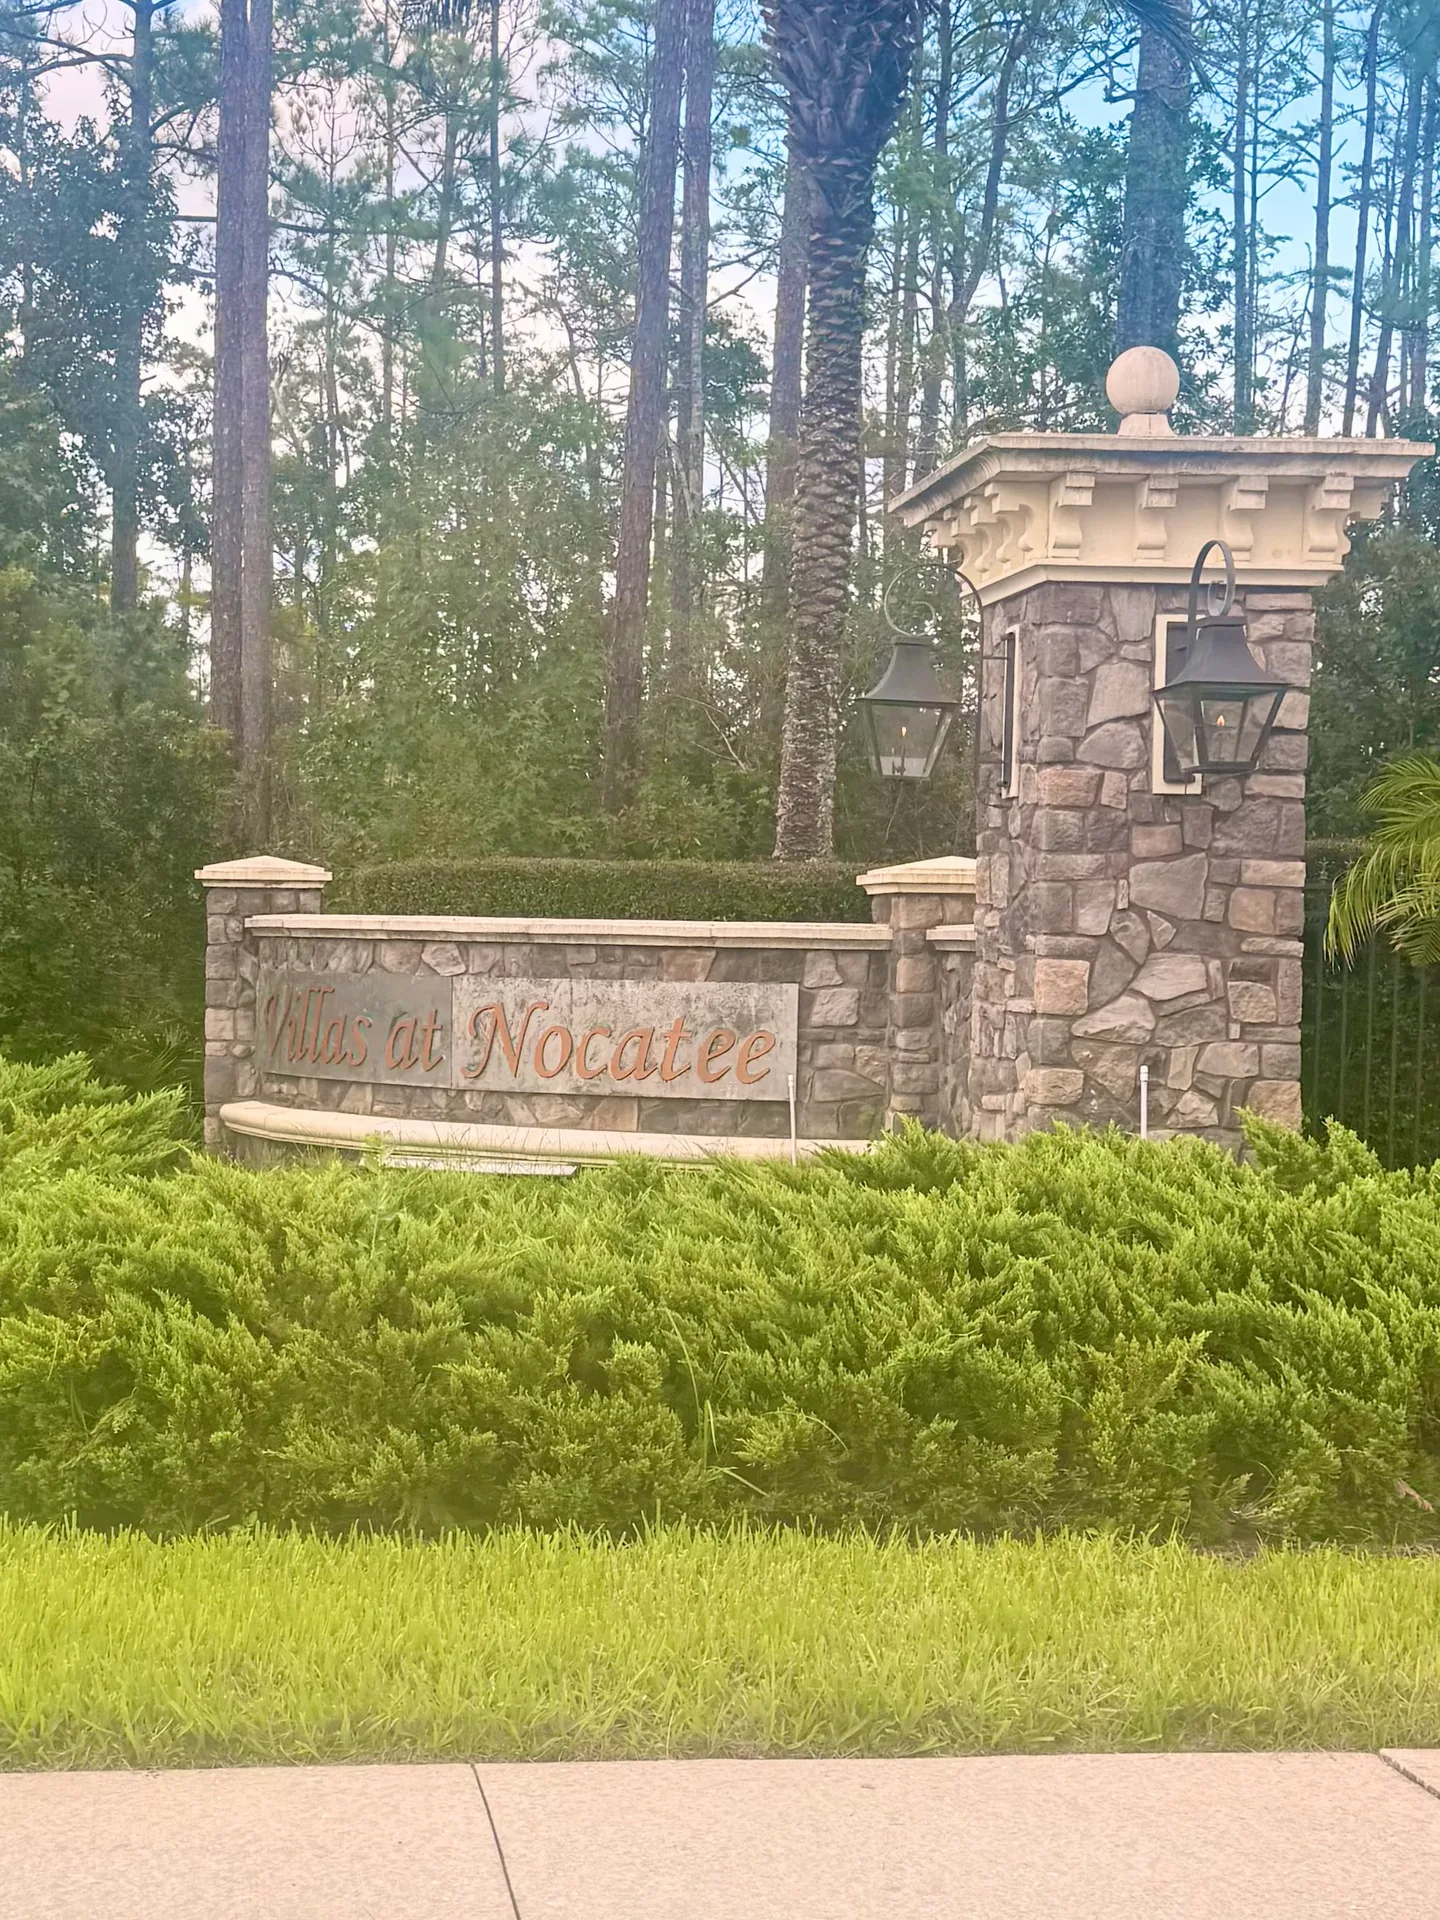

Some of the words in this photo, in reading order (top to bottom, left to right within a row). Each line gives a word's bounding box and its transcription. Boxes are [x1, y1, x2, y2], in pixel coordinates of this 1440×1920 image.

[265, 986, 373, 1067] Villas
[385, 1008, 446, 1073] at
[460, 1001, 776, 1085] Nocatee
